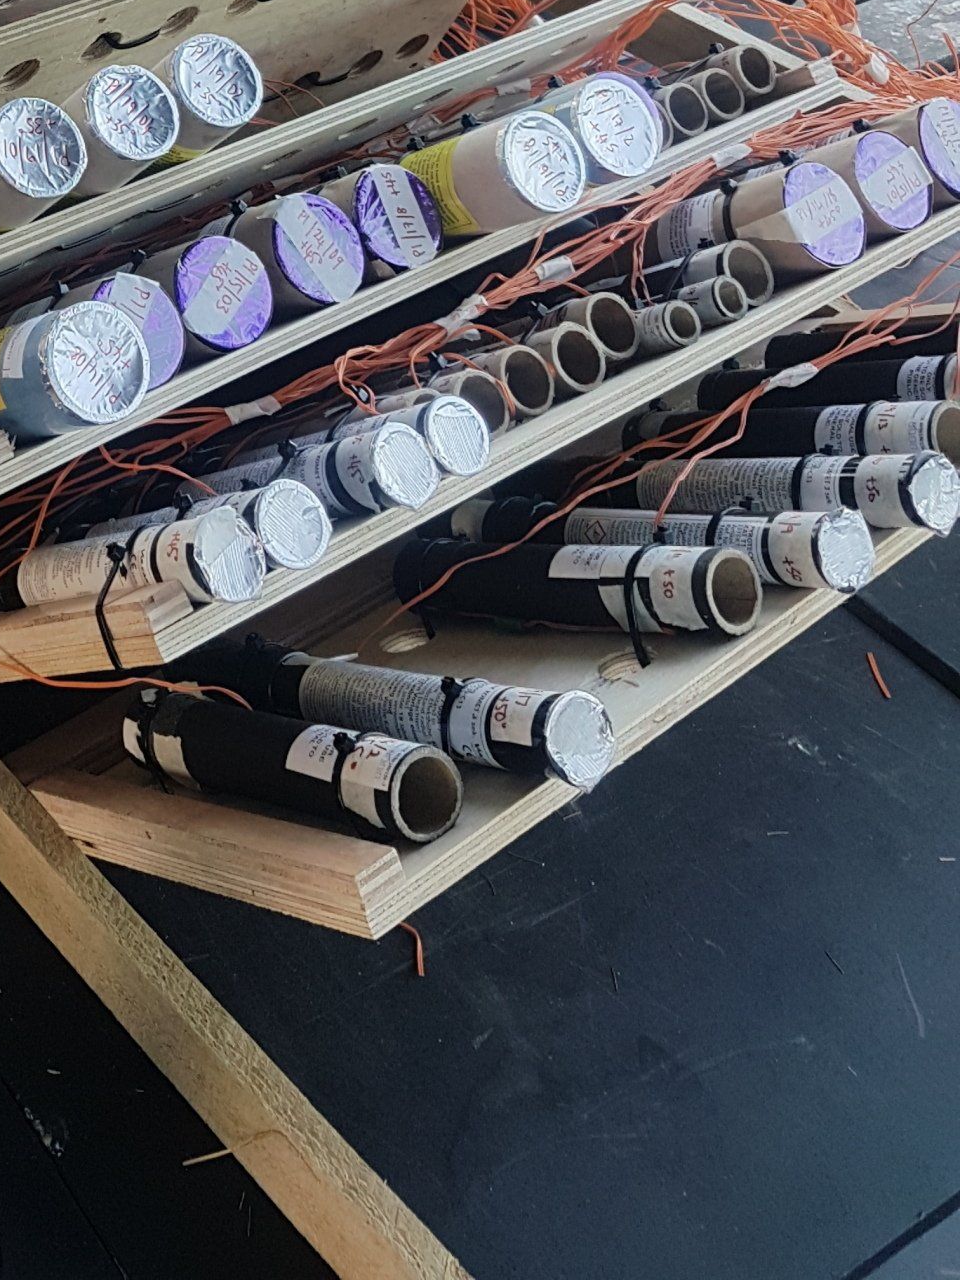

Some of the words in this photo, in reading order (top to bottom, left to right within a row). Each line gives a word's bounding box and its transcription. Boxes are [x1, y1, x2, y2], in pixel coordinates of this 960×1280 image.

[190, 45, 244, 99] P1/19/02
[18, 117, 56, 135] +35°
[105, 116, 137, 136] +35°
[3, 128, 71, 176] P1/19/01
[297, 209, 345, 271] P1/24/09
[215, 257, 259, 315] P1/15/03
[70, 345, 122, 405] P1/14/08
[96, 334, 131, 370] +45°
[661, 569, 674, 600] +50
